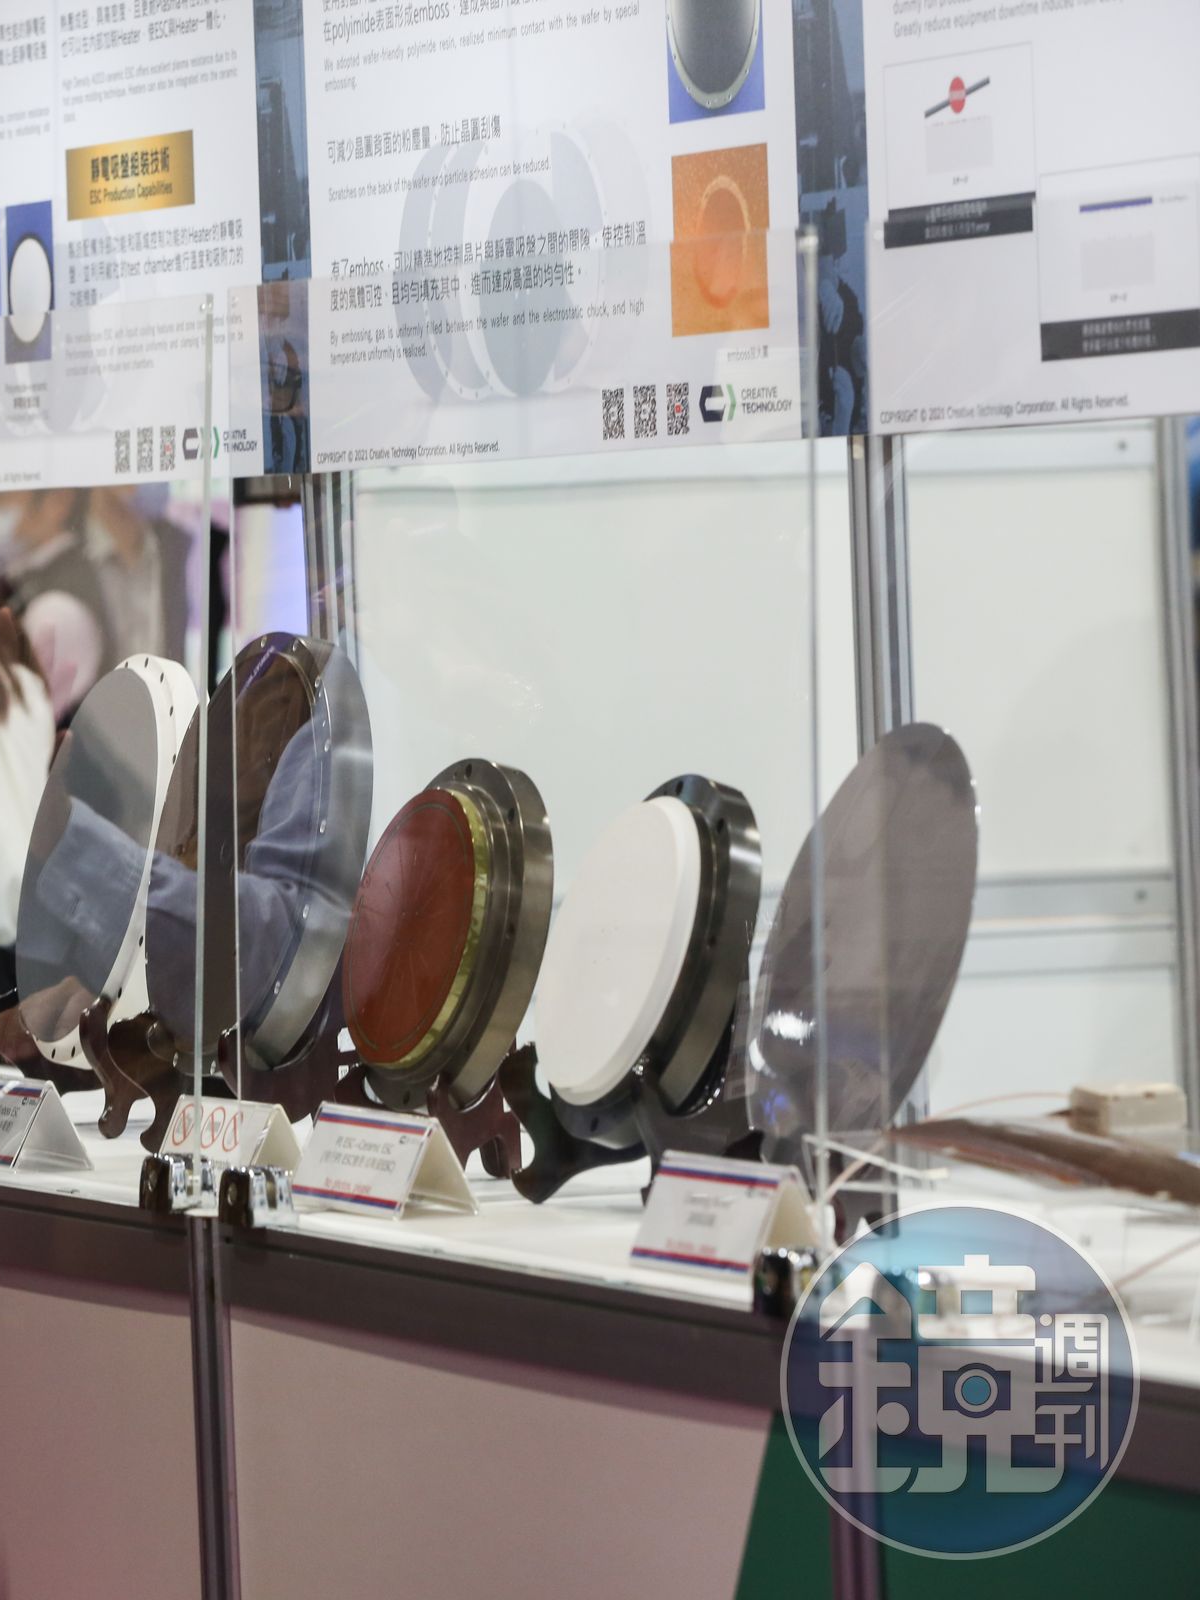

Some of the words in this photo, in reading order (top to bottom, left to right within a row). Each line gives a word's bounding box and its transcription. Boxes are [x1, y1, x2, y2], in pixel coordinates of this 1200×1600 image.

[521, 20, 545, 36] contact
[549, 16, 563, 31] with
[566, 12, 577, 28] the
[581, 8, 600, 25] wafer
[603, 8, 612, 23] by
[103, 186, 136, 202] Production
[137, 181, 173, 200] Capabilities
[378, 180, 392, 195] back
[445, 318, 473, 333] between
[476, 316, 487, 330] the
[490, 312, 509, 328] wafer
[512, 310, 525, 325] and
[529, 308, 540, 323] the
[612, 299, 625, 315] and
[629, 297, 645, 317] high
[741, 386, 778, 400] CREATIVE
[741, 399, 792, 414] TECHNOLOGY
[317, 451, 347, 464] COPYRIGHT
[369, 448, 390, 460] Creative
[391, 446, 417, 460] Technology
[457, 442, 473, 457] Rights
